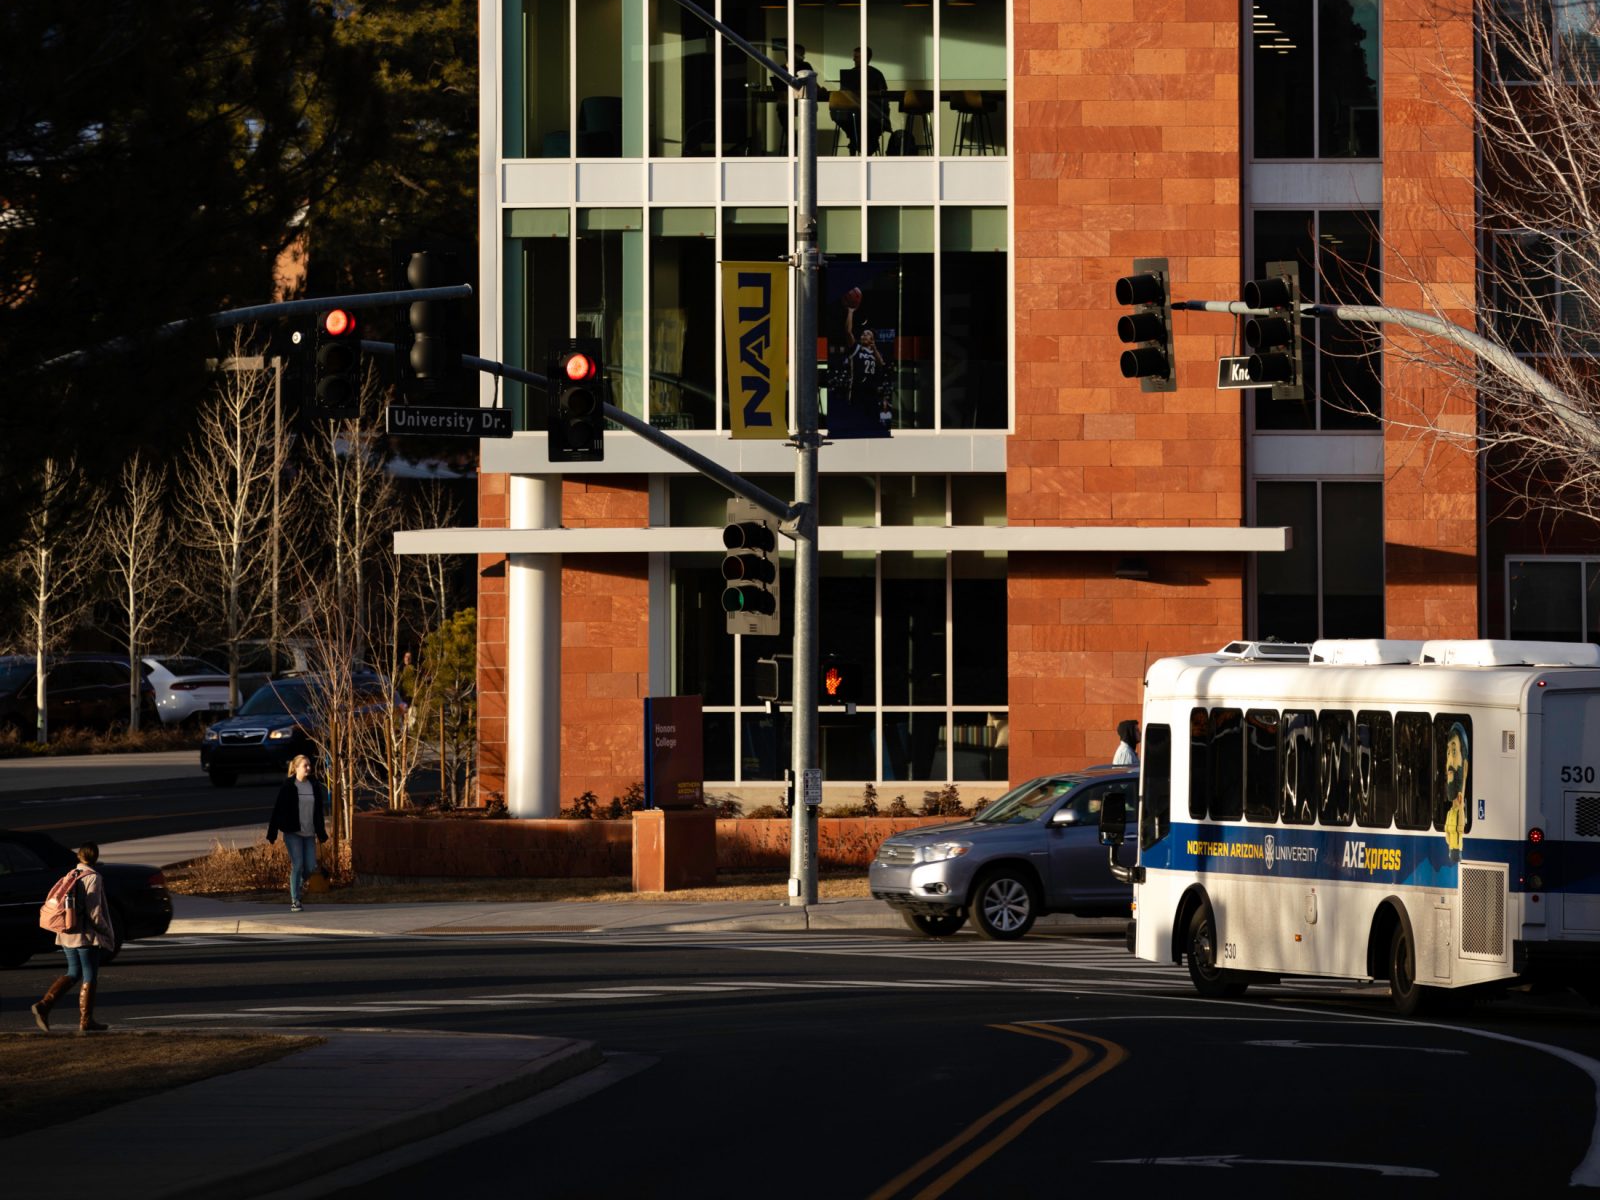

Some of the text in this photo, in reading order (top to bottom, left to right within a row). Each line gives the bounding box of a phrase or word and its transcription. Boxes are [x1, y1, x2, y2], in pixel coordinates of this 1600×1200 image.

[738, 273, 772, 428] NAU
[1231, 363, 1250, 381] Kno
[394, 409, 506, 432] University Dr.
[655, 723, 676, 733] Honors
[655, 737, 677, 749] College
[1561, 766, 1595, 783] 530
[1187, 840, 1319, 862] NORTHERN ARIZONA UNIVERSITY
[1342, 831, 1402, 875] AXExpress
[1224, 942, 1237, 959] 530
